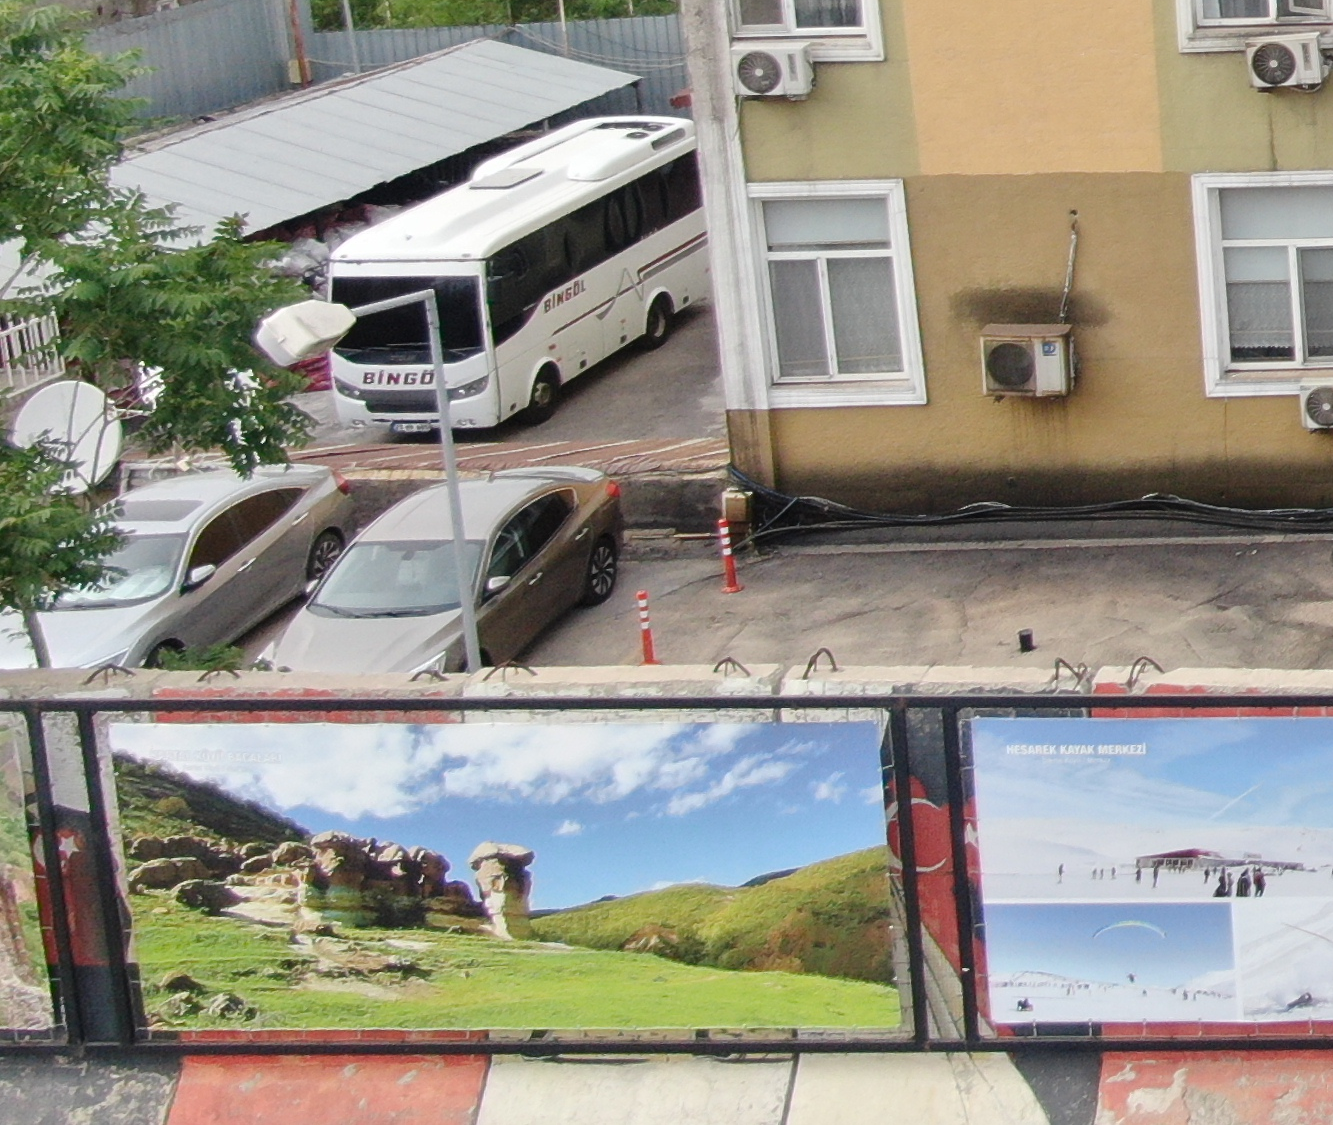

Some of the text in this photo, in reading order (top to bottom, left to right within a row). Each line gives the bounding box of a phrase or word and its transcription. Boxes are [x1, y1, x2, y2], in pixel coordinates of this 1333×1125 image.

[544, 280, 587, 315] BİNGÖL
[363, 369, 447, 386] BİNGÖ
[1006, 742, 1147, 755] HESAREK KAYAK MERKEZİ
